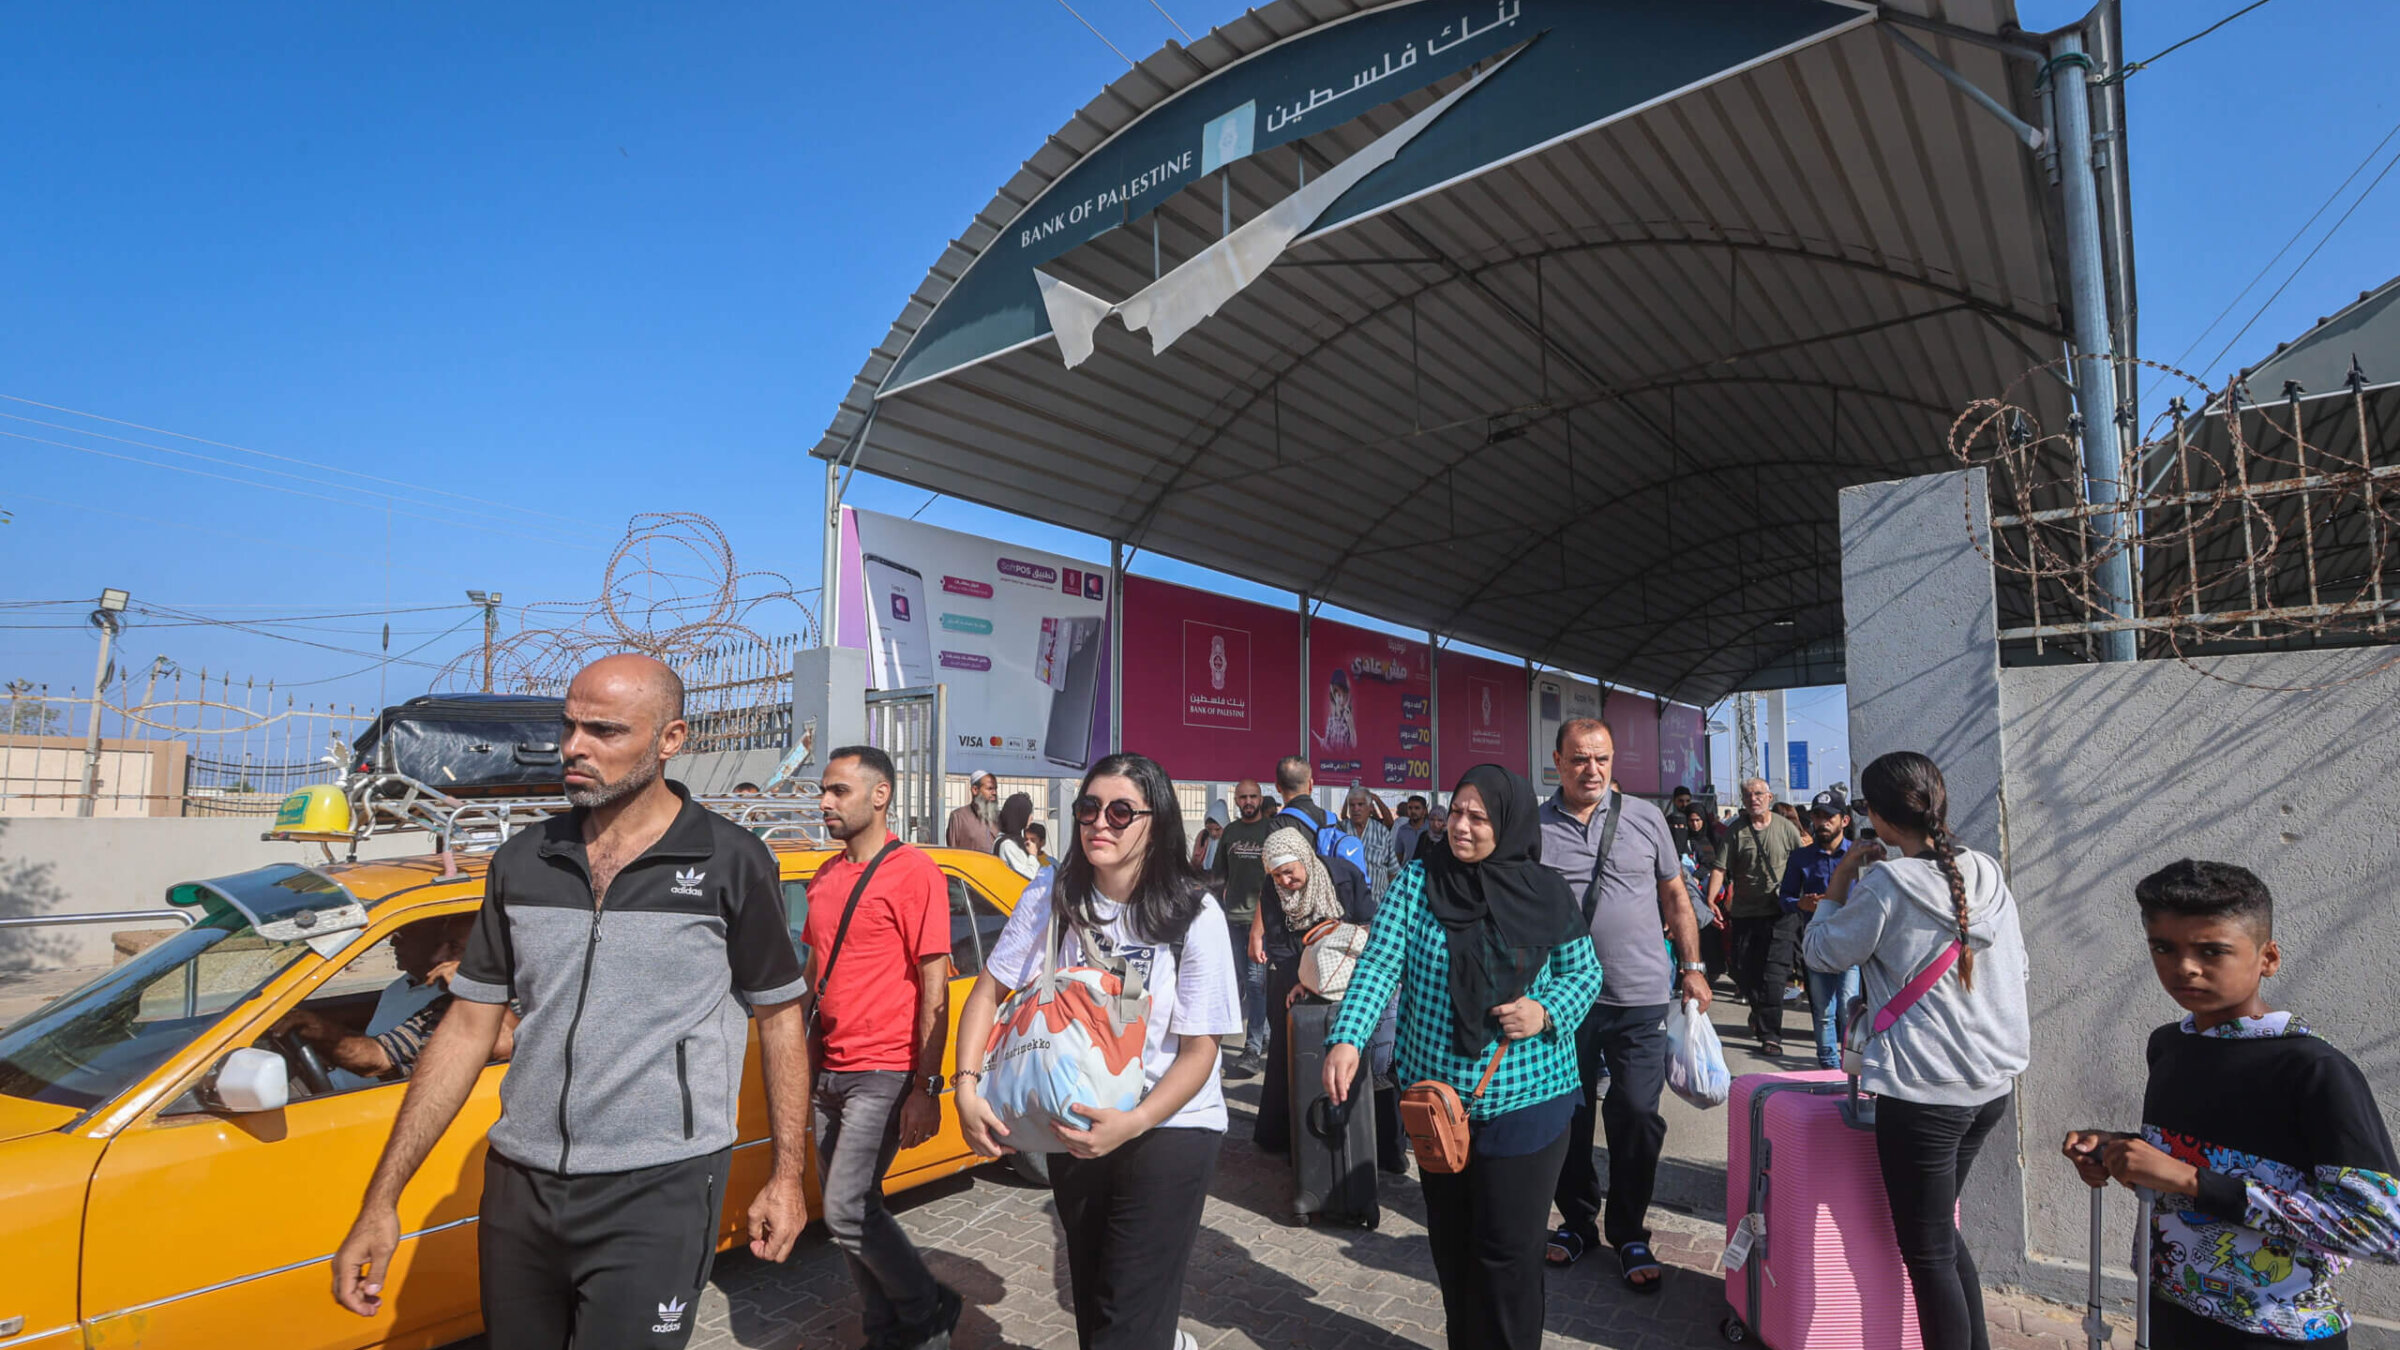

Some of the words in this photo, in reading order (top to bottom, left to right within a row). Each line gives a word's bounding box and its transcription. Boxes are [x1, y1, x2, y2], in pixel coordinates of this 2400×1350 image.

[1267, 43, 1418, 133] فلسطين
[1021, 212, 1065, 248] BANK
[1069, 199, 1093, 224] OF
[1098, 149, 1192, 212] PALESTINE
[1190, 705, 1207, 714] BANK
[1207, 707, 1215, 715] OF
[1216, 708, 1245, 718] PALESTINE
[1421, 700, 1428, 715] 7
[959, 735, 983, 747] VISA
[1418, 729, 1430, 743] 70
[1407, 760, 1430, 778] 700
[671, 885, 703, 897] adidas
[652, 1322, 681, 1333] adidas
